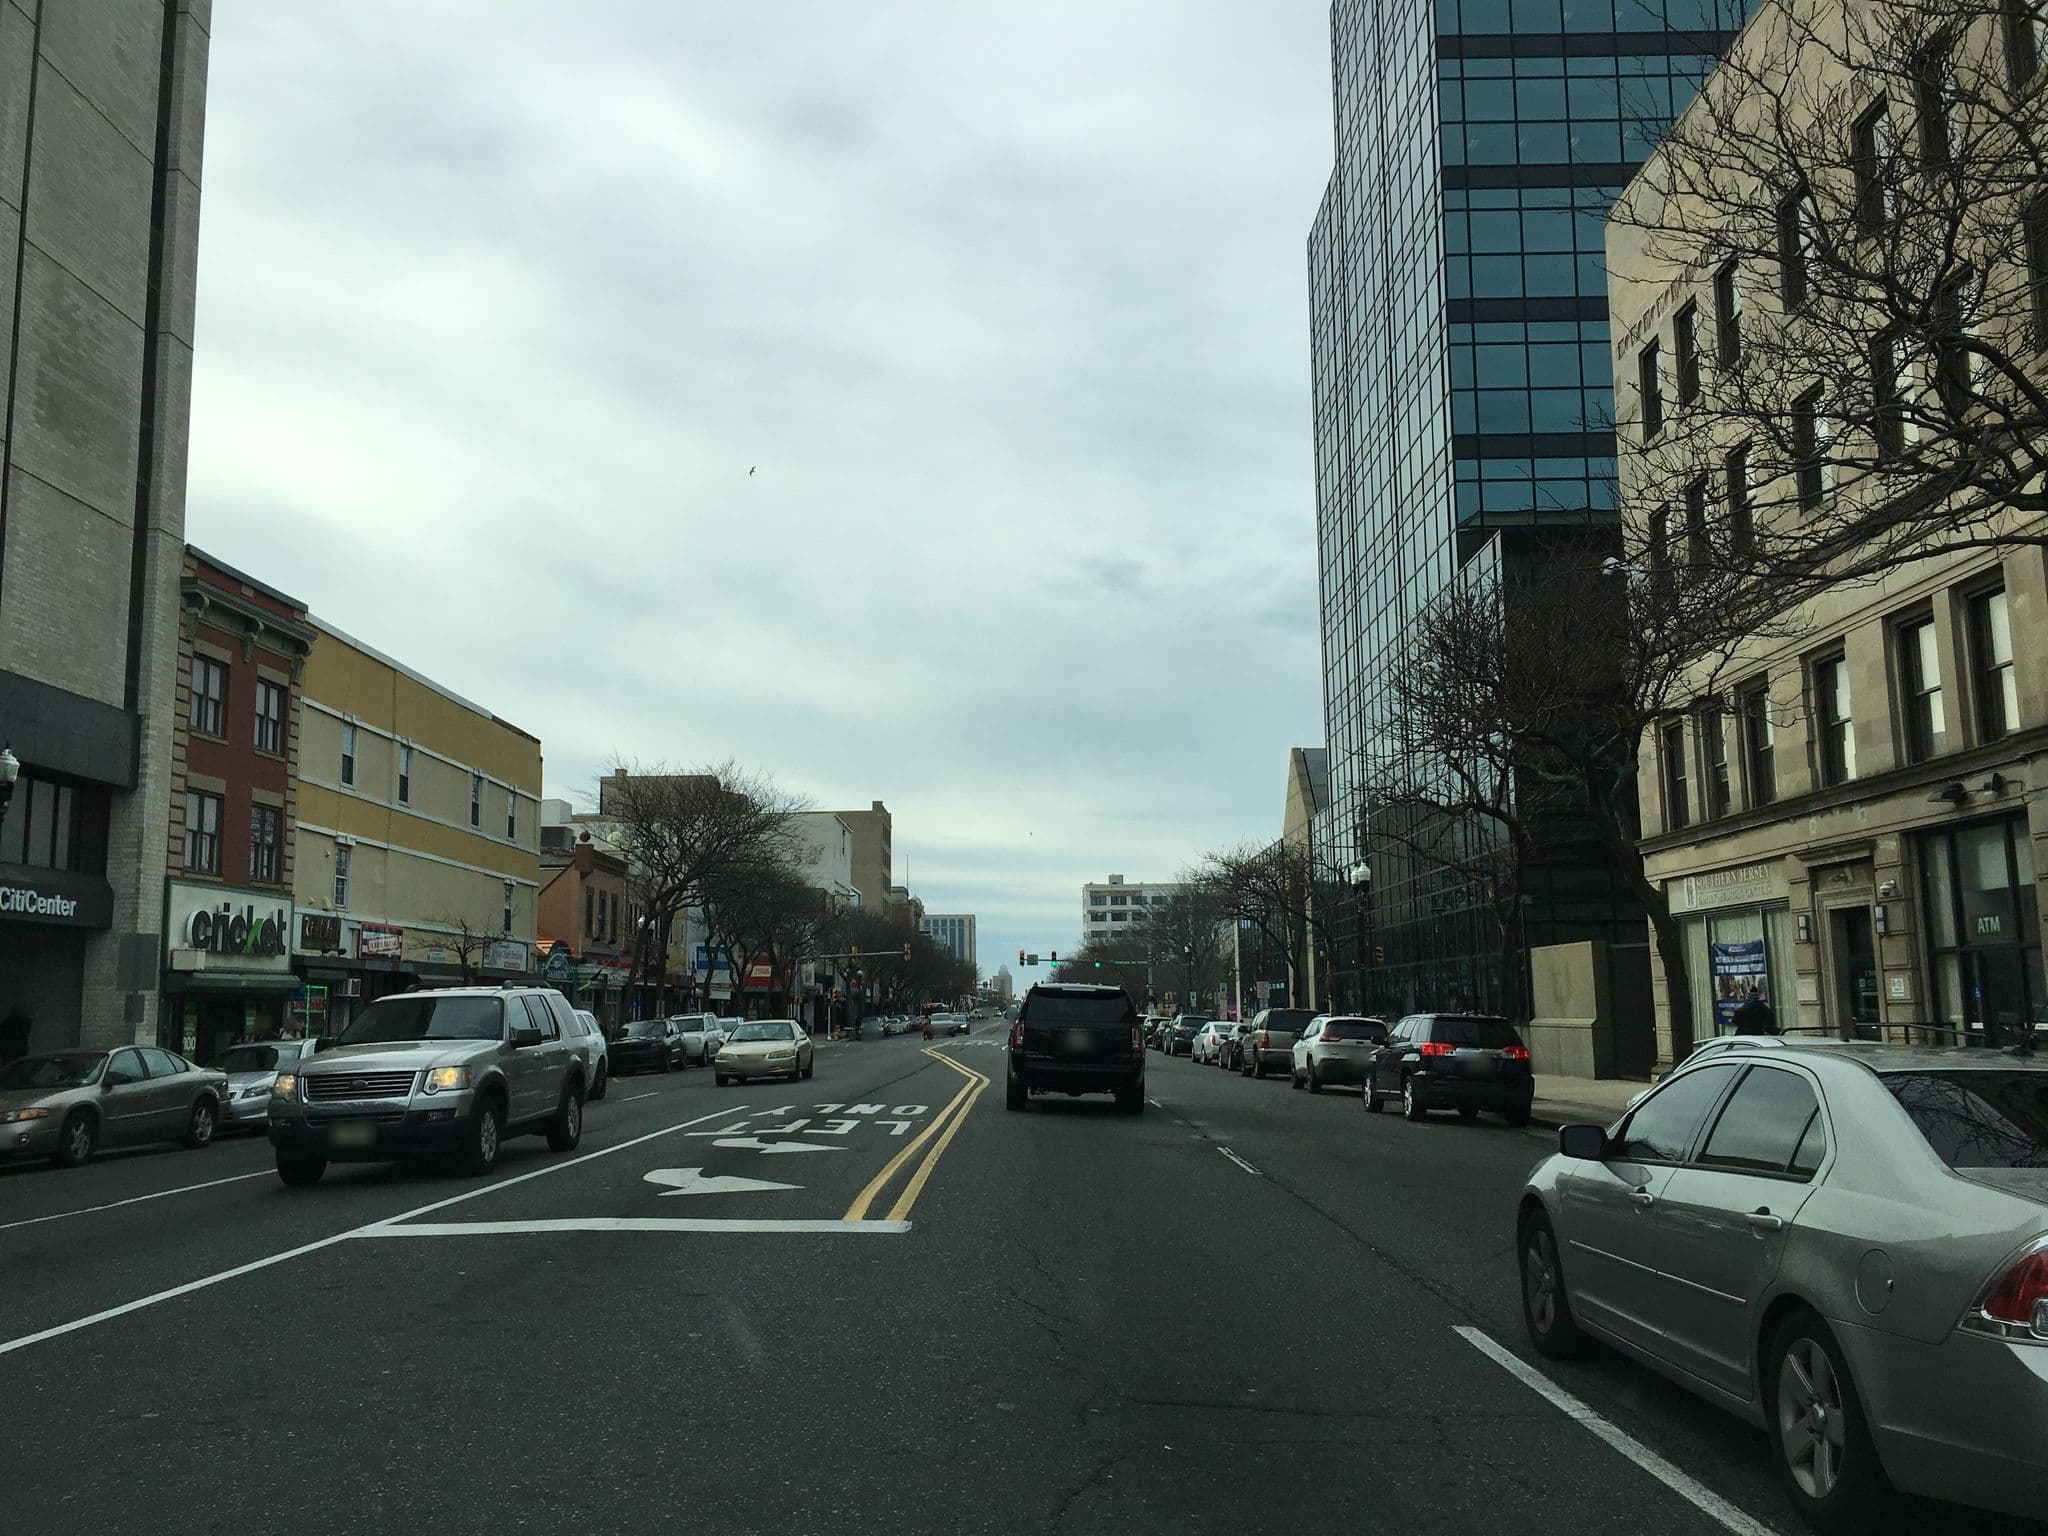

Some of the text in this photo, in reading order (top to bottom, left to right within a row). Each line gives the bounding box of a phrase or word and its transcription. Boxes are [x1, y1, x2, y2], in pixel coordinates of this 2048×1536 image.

[1695, 864, 1769, 889] SOUTHERN JERSEY
[0, 886, 77, 917] CitiCenter
[187, 902, 287, 955] cricket
[1978, 916, 2001, 933] ATM
[749, 1103, 929, 1116] ONLY
[684, 1119, 913, 1136] LEFT
